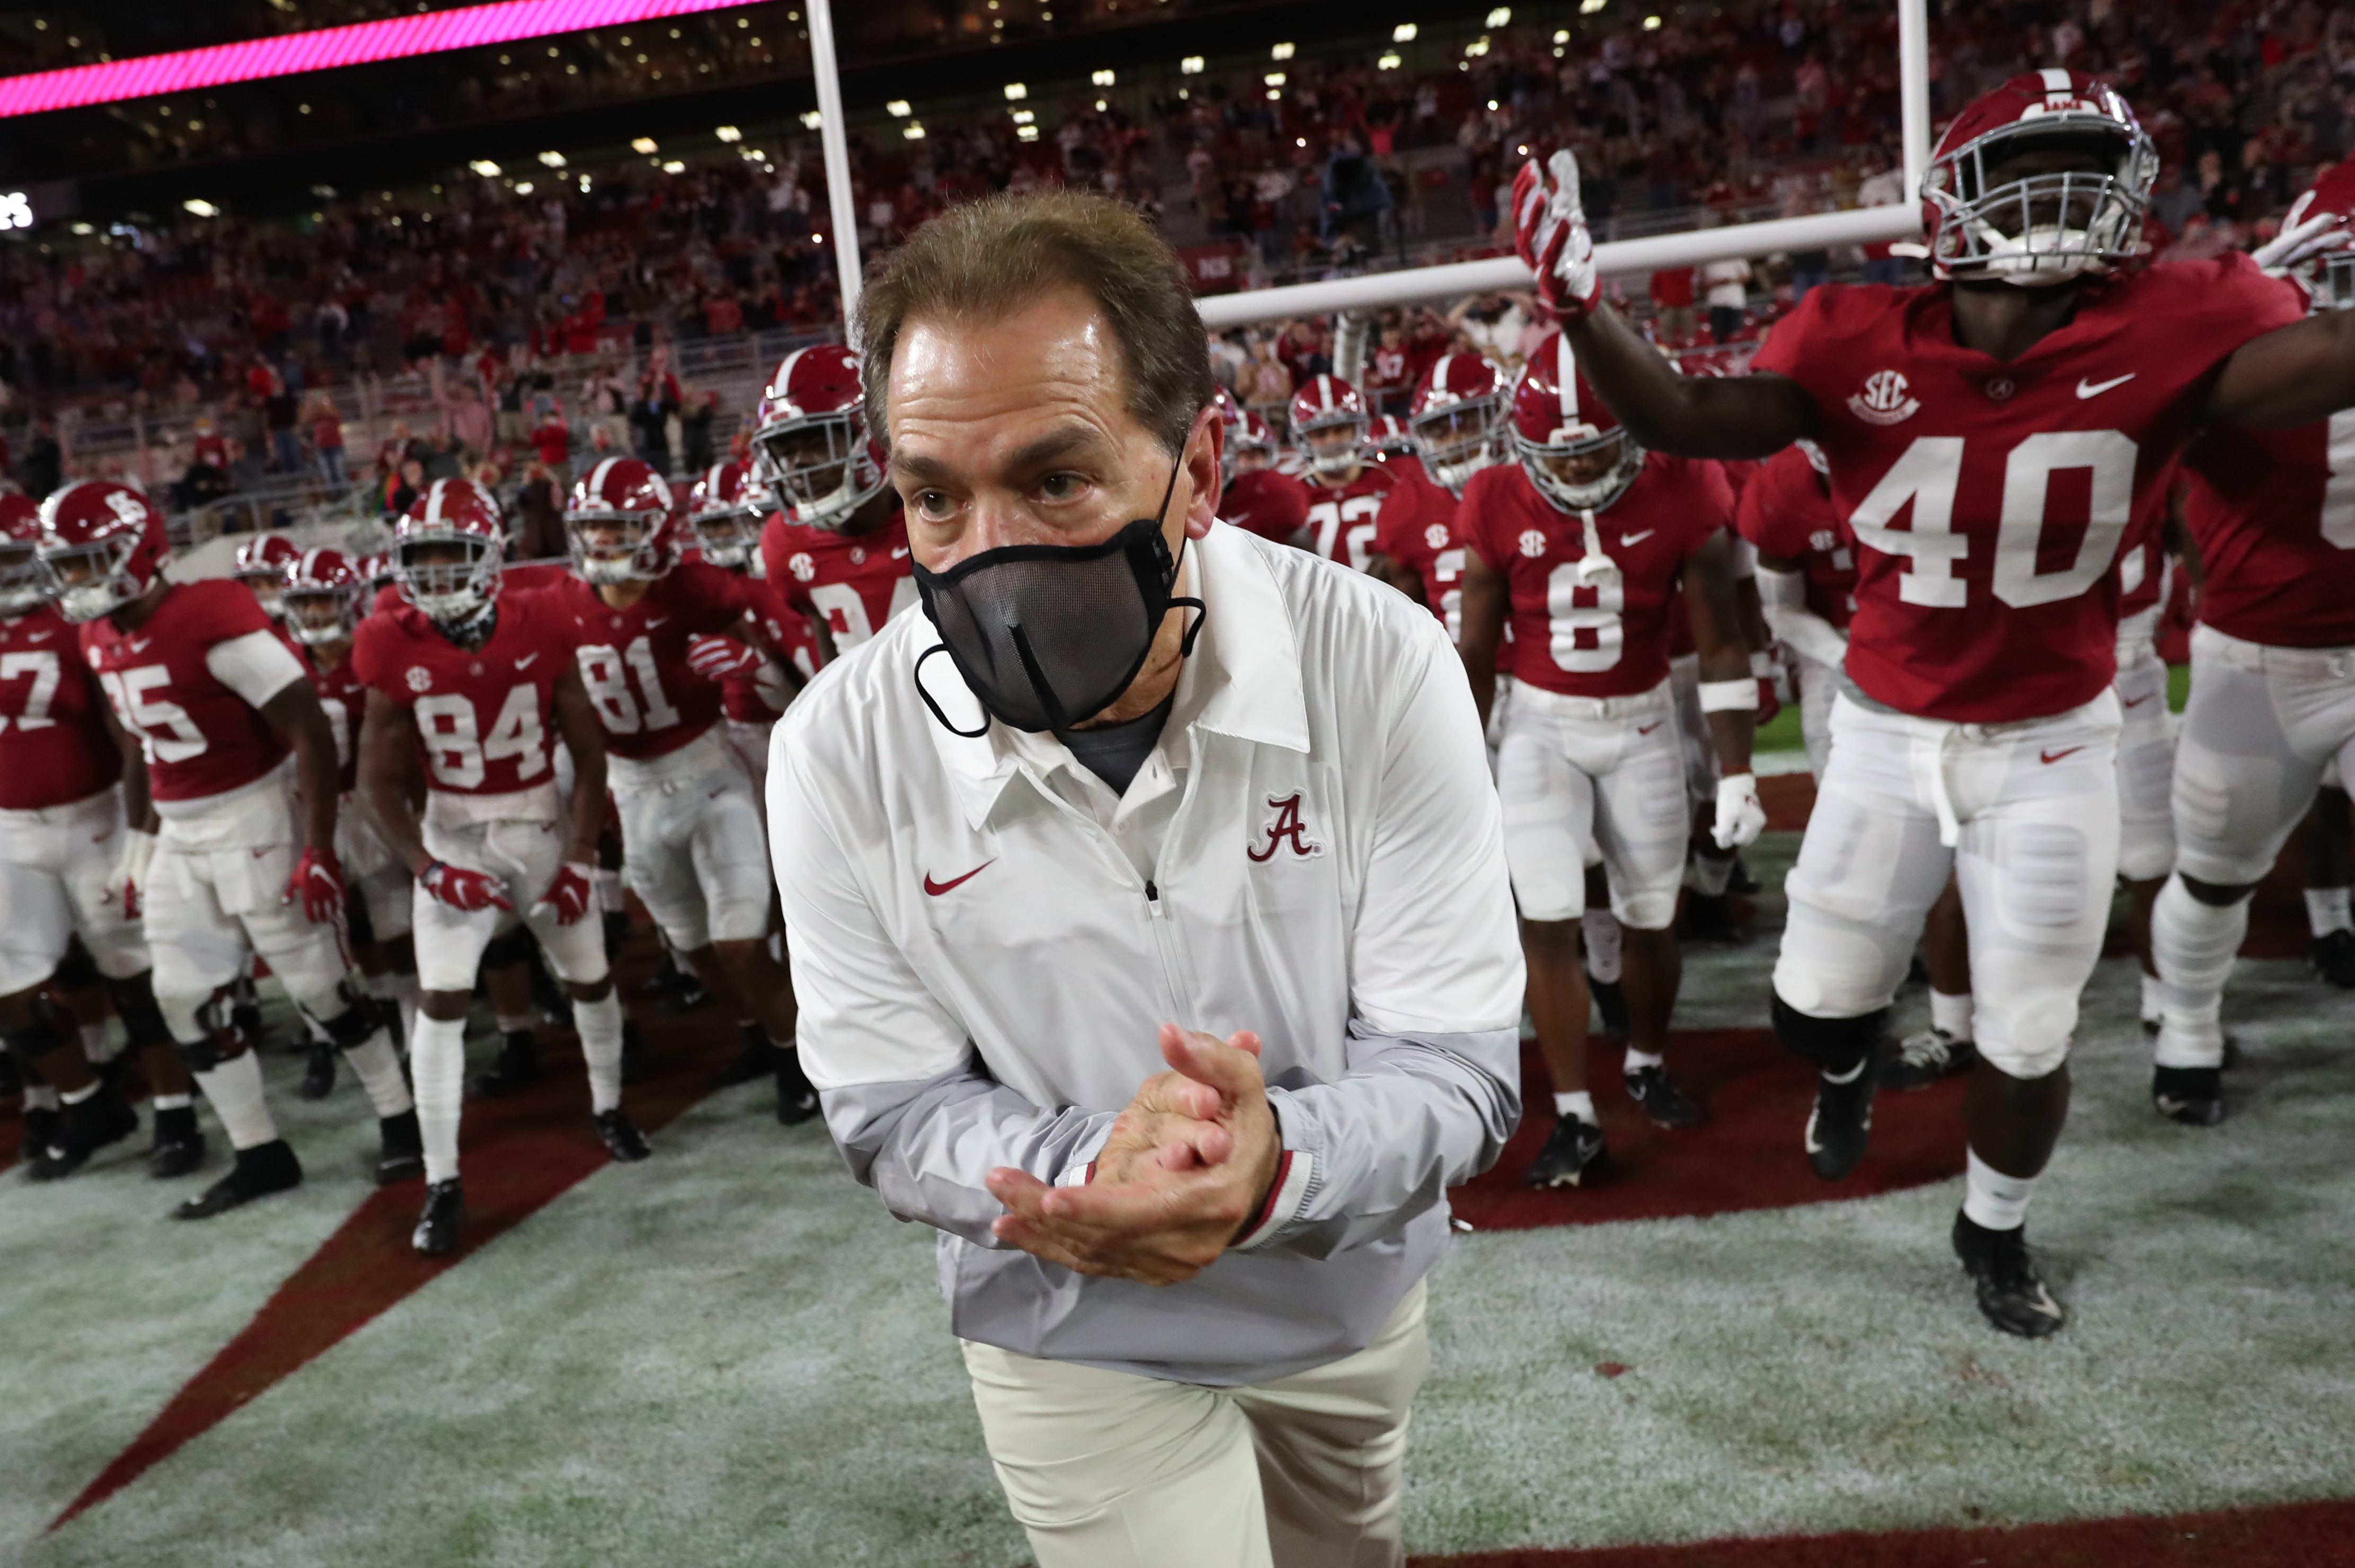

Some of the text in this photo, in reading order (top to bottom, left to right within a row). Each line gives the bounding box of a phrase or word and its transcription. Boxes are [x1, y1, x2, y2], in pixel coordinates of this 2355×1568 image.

[1864, 369, 1908, 410] SEC
[1304, 495, 1382, 572] 72
[1848, 429, 2139, 608] 40
[1548, 562, 1623, 672] 8
[414, 683, 546, 789] 84
[576, 636, 680, 734] 81
